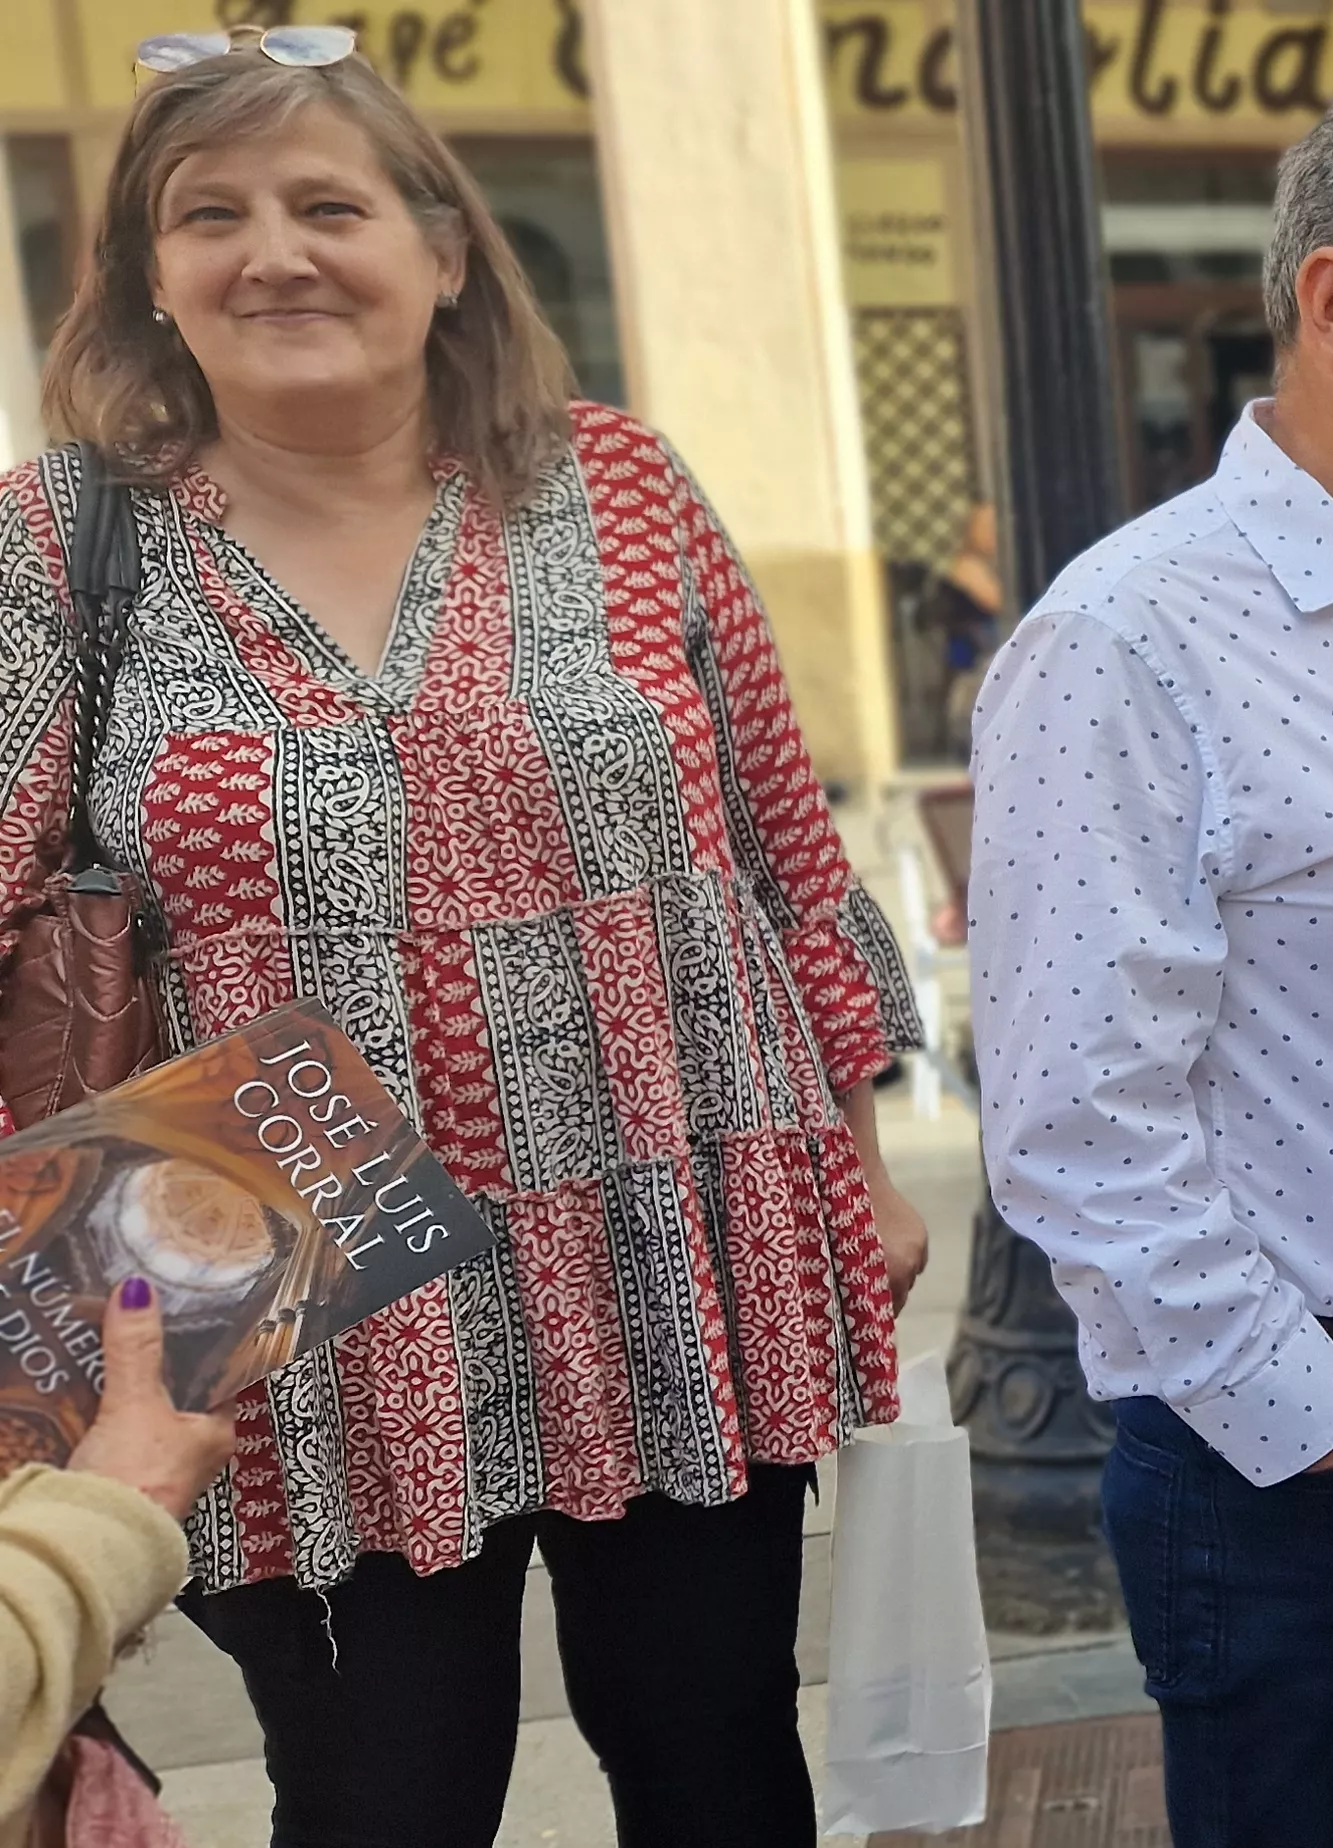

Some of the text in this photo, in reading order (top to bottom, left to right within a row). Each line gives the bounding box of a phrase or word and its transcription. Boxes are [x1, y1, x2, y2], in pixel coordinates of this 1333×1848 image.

[234, 1081, 385, 1271] CORRAL
[259, 1040, 451, 1254] JOSÉ LUIS
[0, 1310, 70, 1395] DIOS
[8, 1252, 105, 1395] NÚMER
